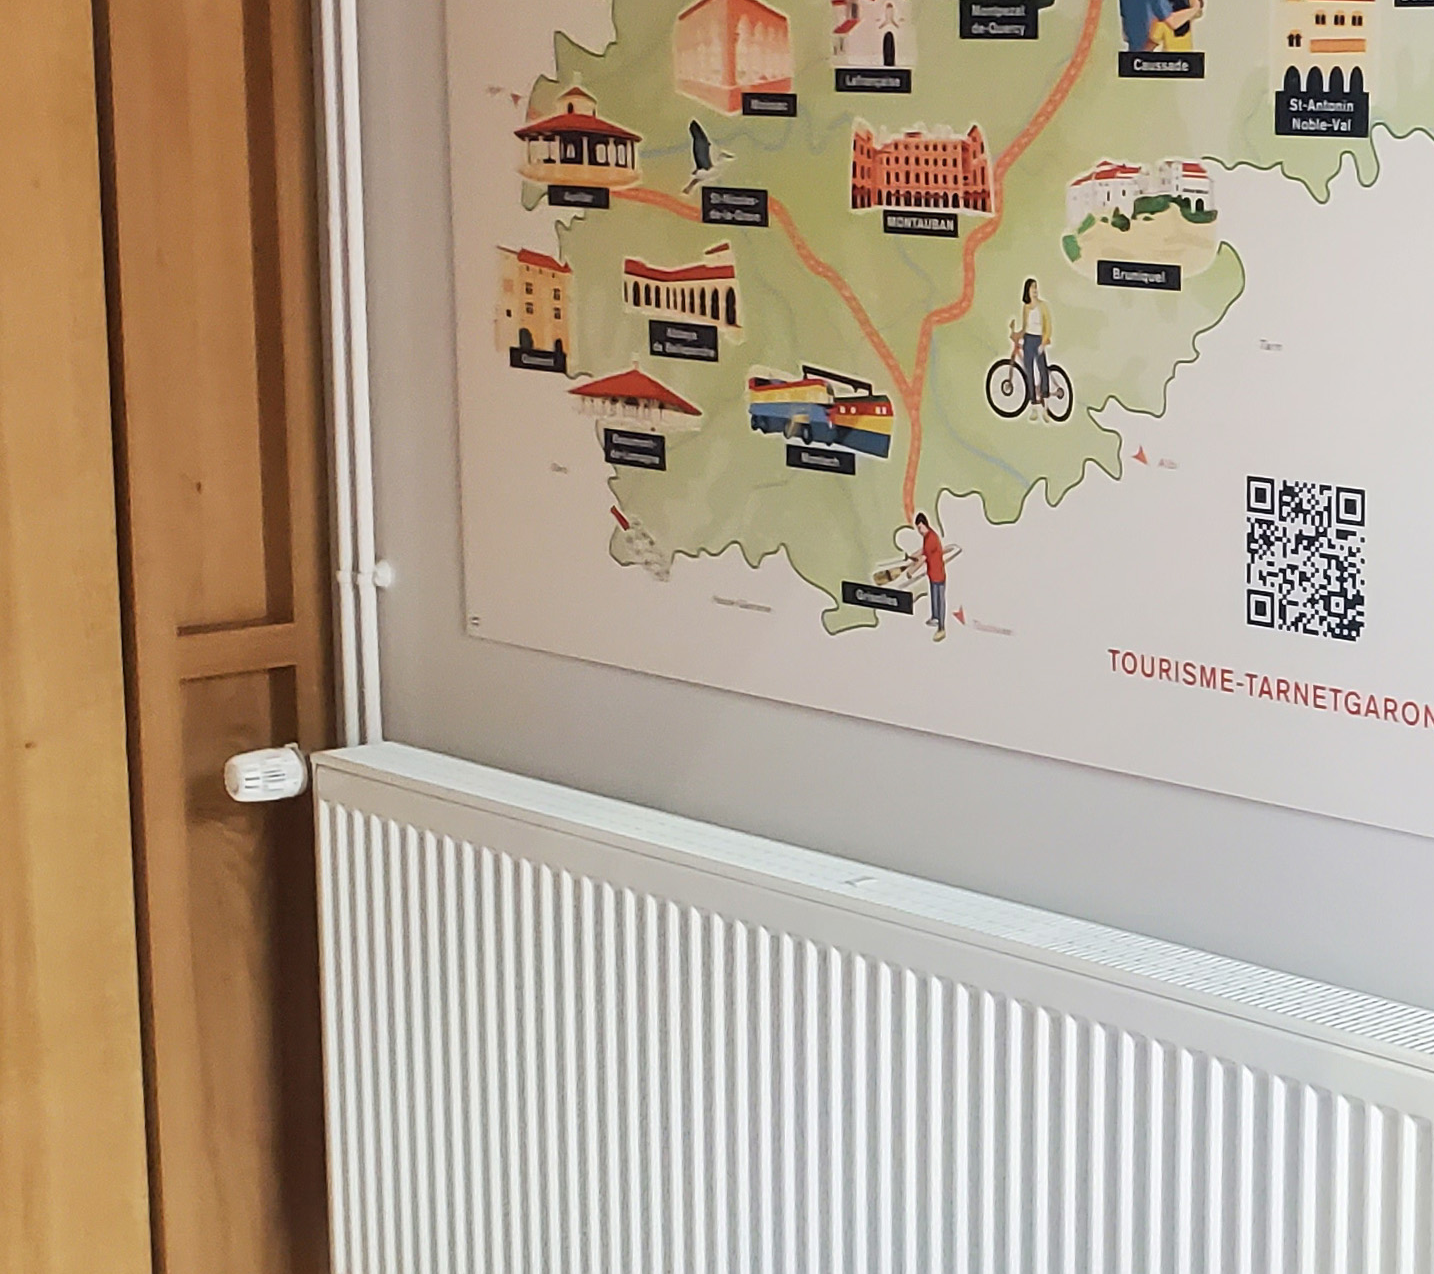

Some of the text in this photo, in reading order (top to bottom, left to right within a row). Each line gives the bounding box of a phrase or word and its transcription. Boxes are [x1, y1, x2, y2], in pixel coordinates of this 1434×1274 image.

[1133, 58, 1190, 73] Caussade
[1289, 98, 1354, 113] St-Antonin
[1292, 118, 1352, 133] Noble-Val
[886, 215, 955, 233] MONTAUBAN
[1112, 267, 1167, 285] Bruniquel
